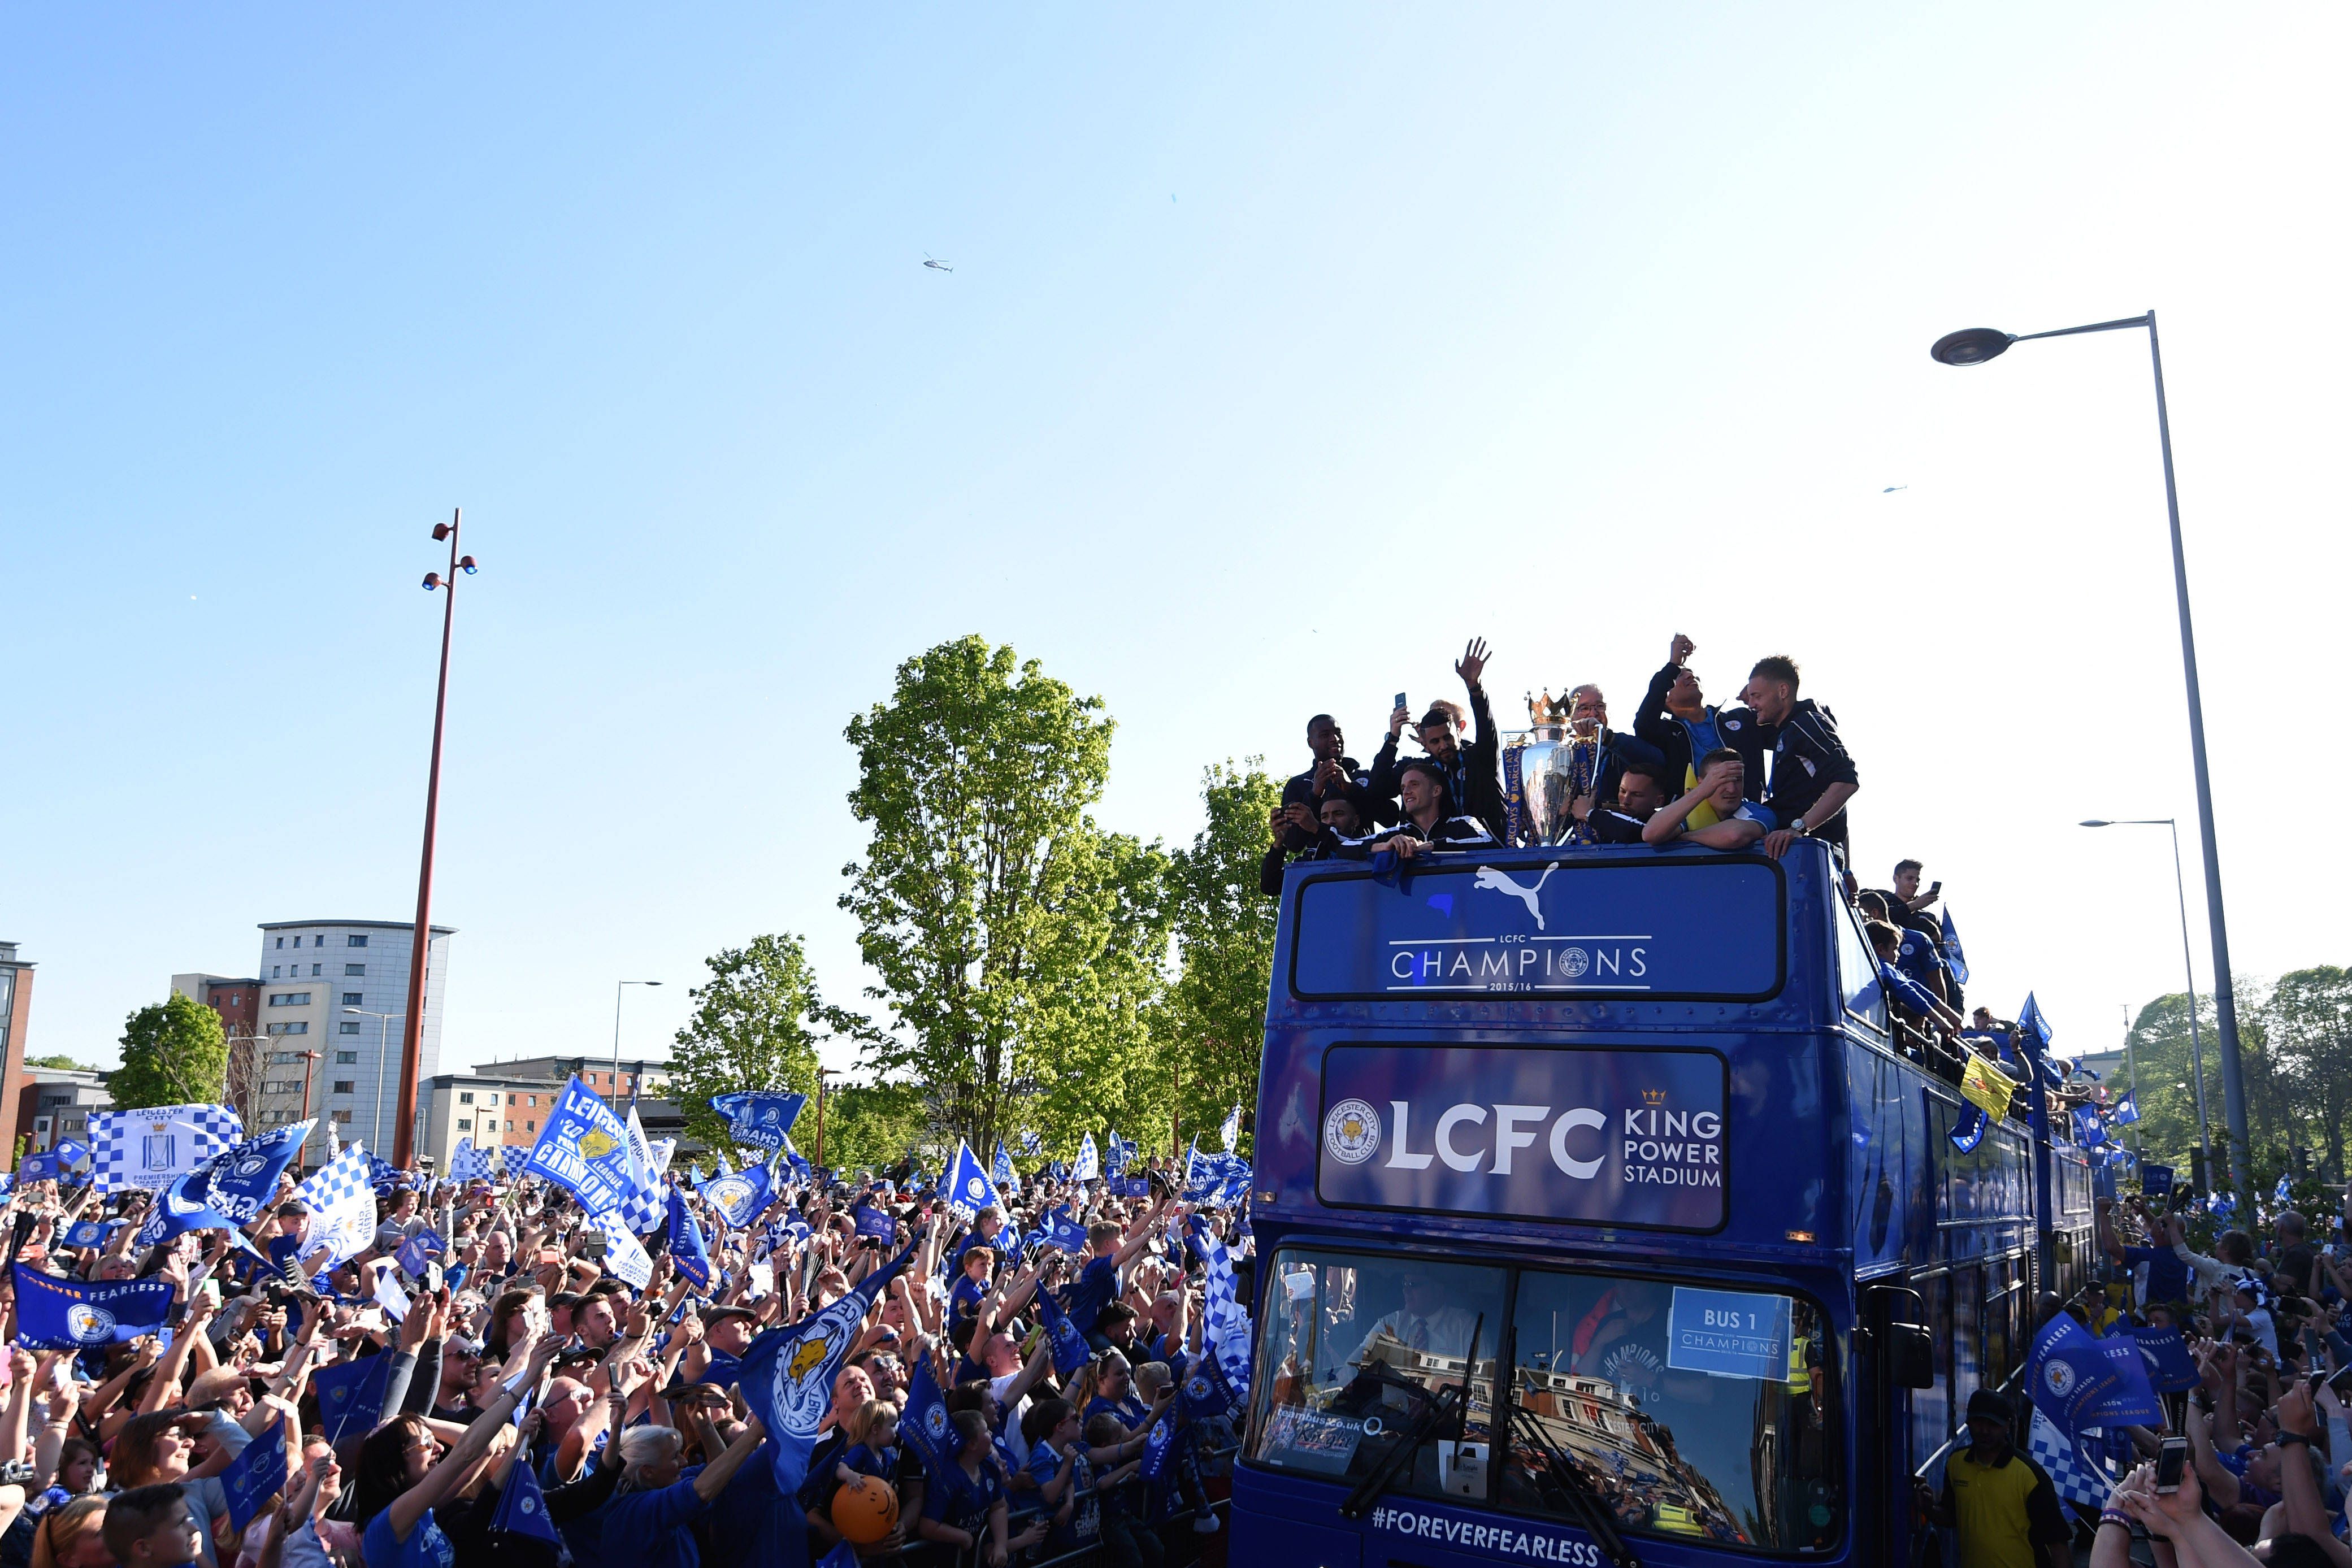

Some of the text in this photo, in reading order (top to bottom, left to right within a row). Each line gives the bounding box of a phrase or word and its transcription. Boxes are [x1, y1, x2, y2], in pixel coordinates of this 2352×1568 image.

[1511, 748, 1524, 791] BARCLAYS
[1507, 807, 1518, 847] ARCLAYS
[1500, 935, 1526, 943] LCFC
[1392, 947, 1646, 978] CHAMPIONS
[1490, 983, 1531, 992] 2015/16
[136, 1108, 184, 1117] LEICESTER
[1330, 1104, 1376, 1130] LEICESTER CITY
[1625, 1109, 1721, 1139] KING
[1329, 1133, 1375, 1159] FOOTBALL CLUB
[1384, 1100, 1607, 1179] LCFC
[1625, 1140, 1719, 1164] POWER
[592, 1160, 624, 1190] LEAGUE
[1624, 1166, 1721, 1187] STADIUM
[363, 1200, 372, 1241] LEICESTER
[89, 1283, 165, 1301] FEARLESS
[1704, 1309, 1755, 1330] BUS 1
[1682, 1334, 1778, 1354] CHAMPIONS
[2037, 1323, 2072, 1362] FEARLESS
[2103, 1347, 2129, 1358] LESS
[2136, 1335, 2175, 1345] FEARLESS
[2073, 1374, 2096, 1395] SEASON
[1372, 1506, 1601, 1567] #FOREVERFEARLESS
